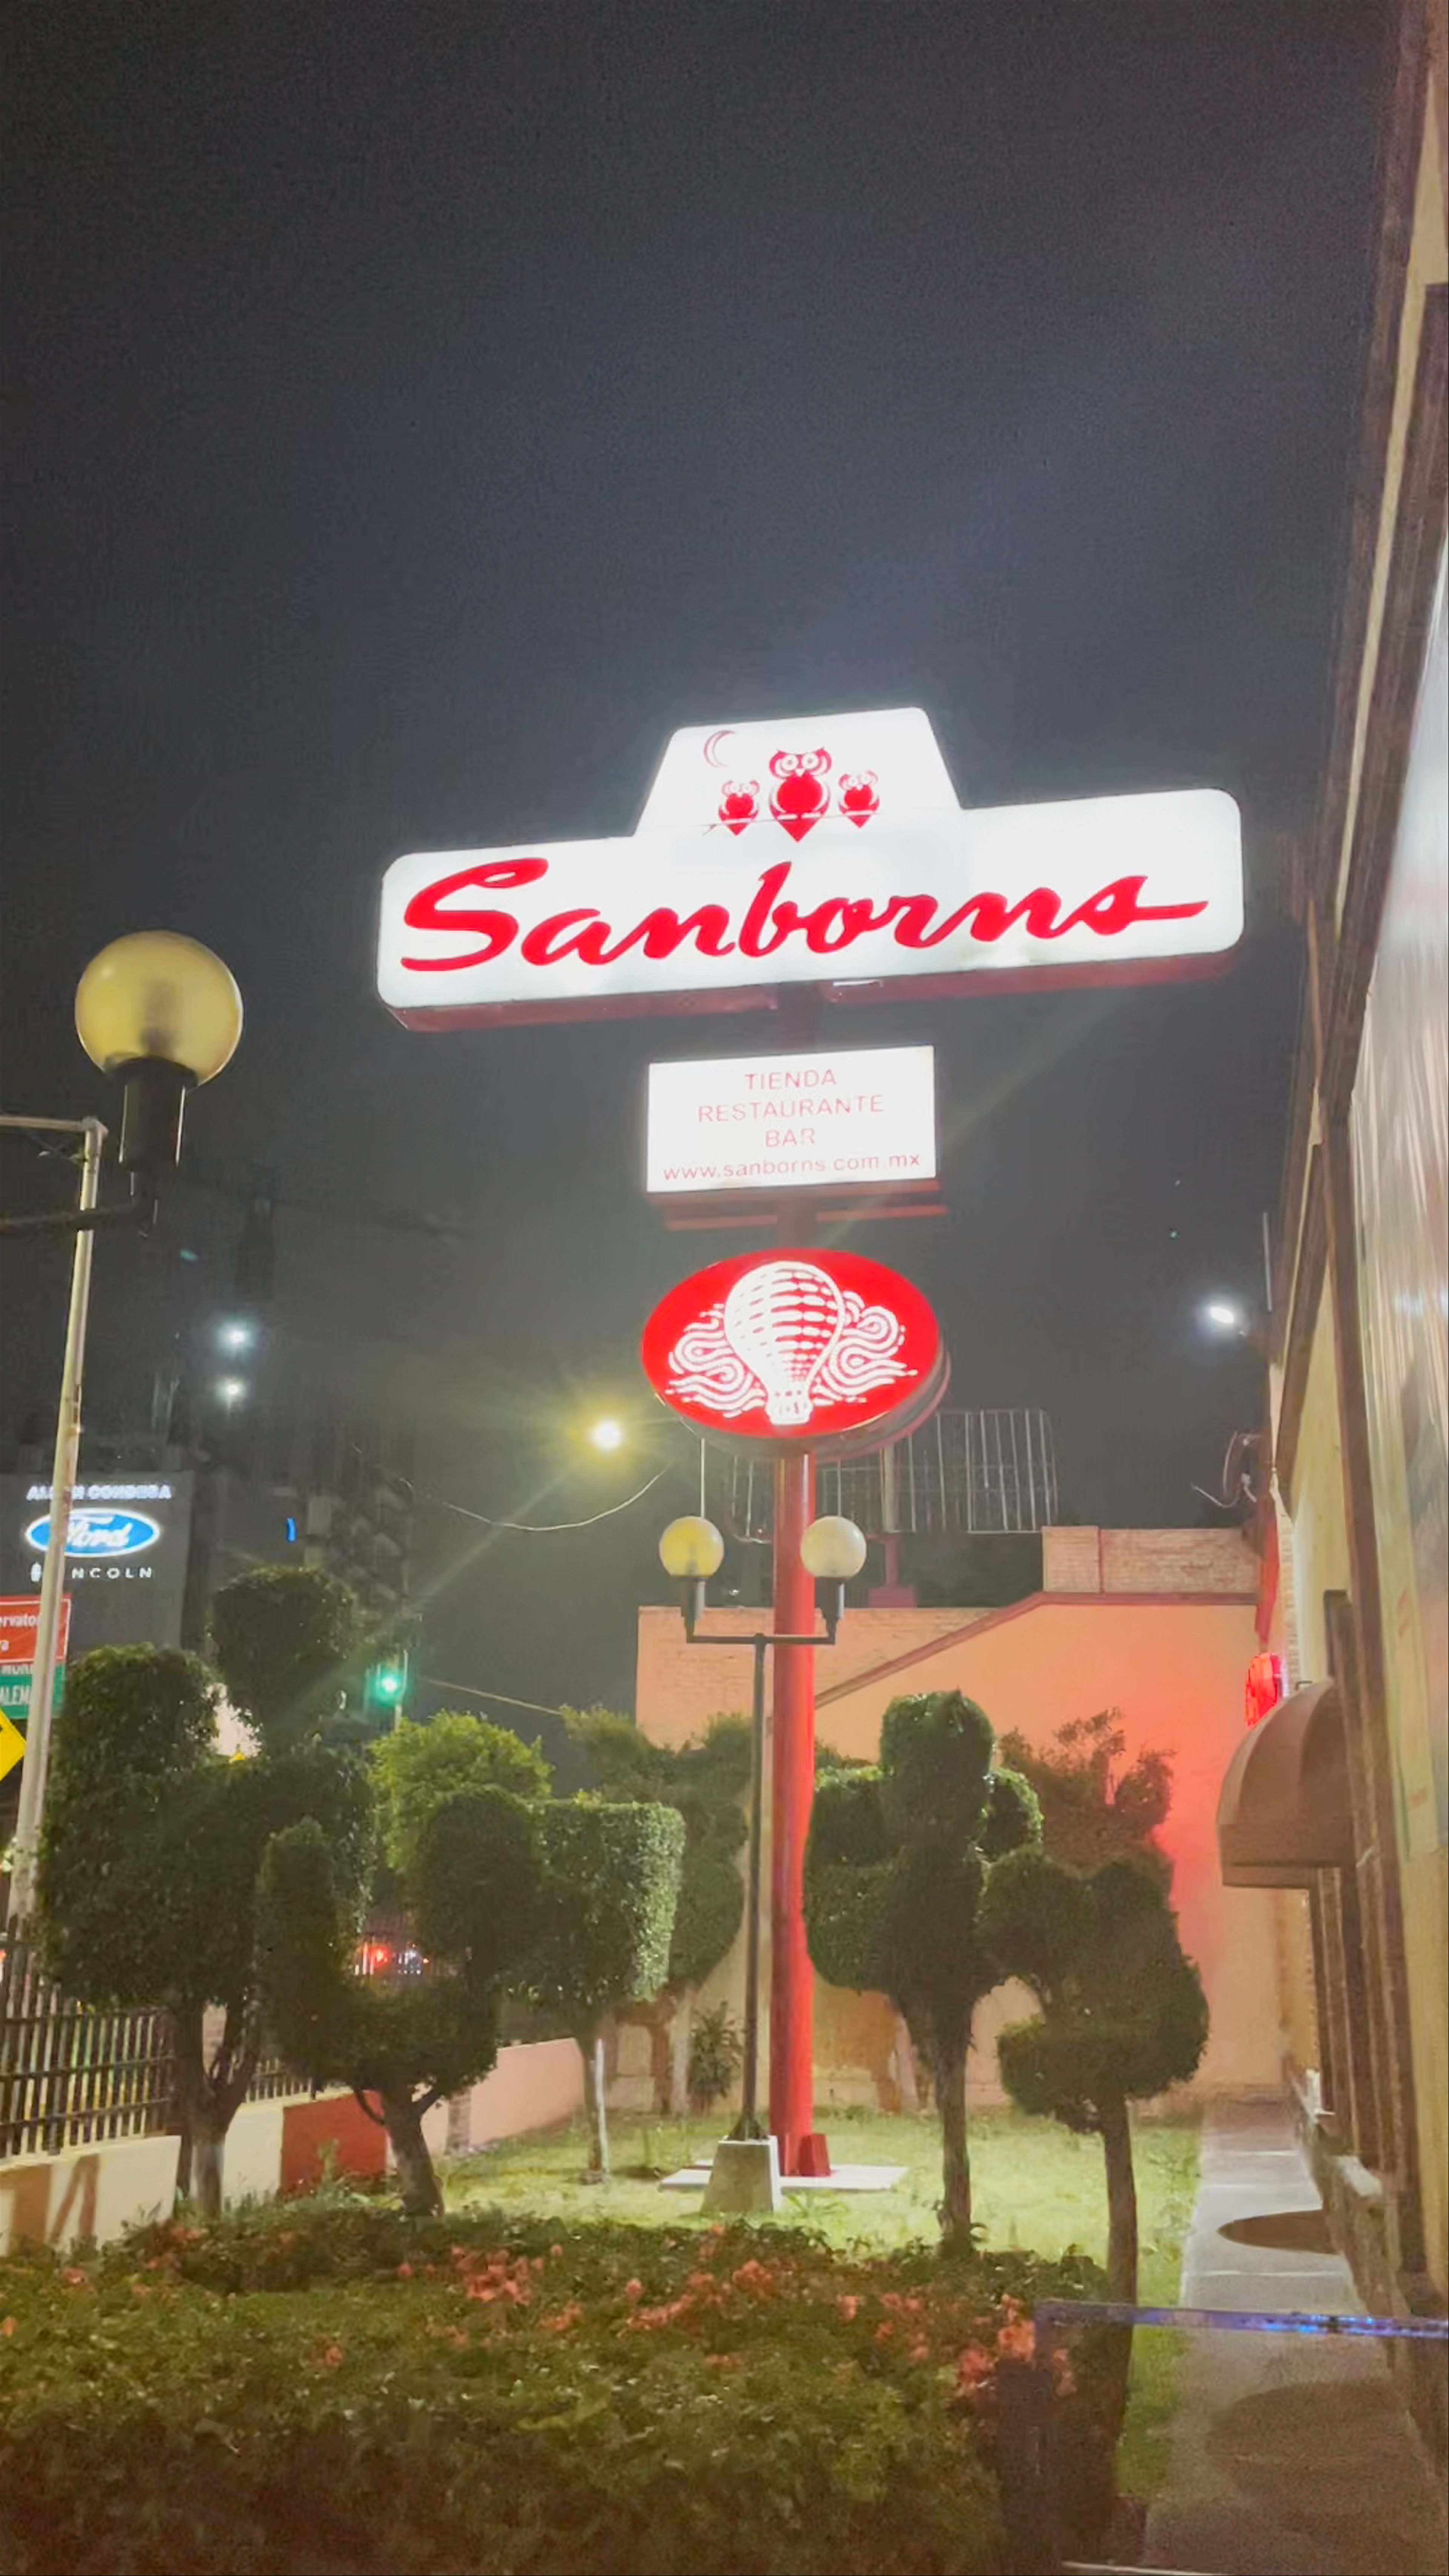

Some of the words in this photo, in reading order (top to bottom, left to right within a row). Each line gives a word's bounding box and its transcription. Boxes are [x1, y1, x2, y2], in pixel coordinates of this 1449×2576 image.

[401, 857, 1209, 972] Sanborns
[744, 1069, 837, 1090] TIENDA
[697, 1094, 885, 1123] RESTAURANTE
[764, 1127, 815, 1148] BAR
[663, 1153, 921, 1181] www.sanbornscommx
[71, 1567, 152, 1579] NCOLN
